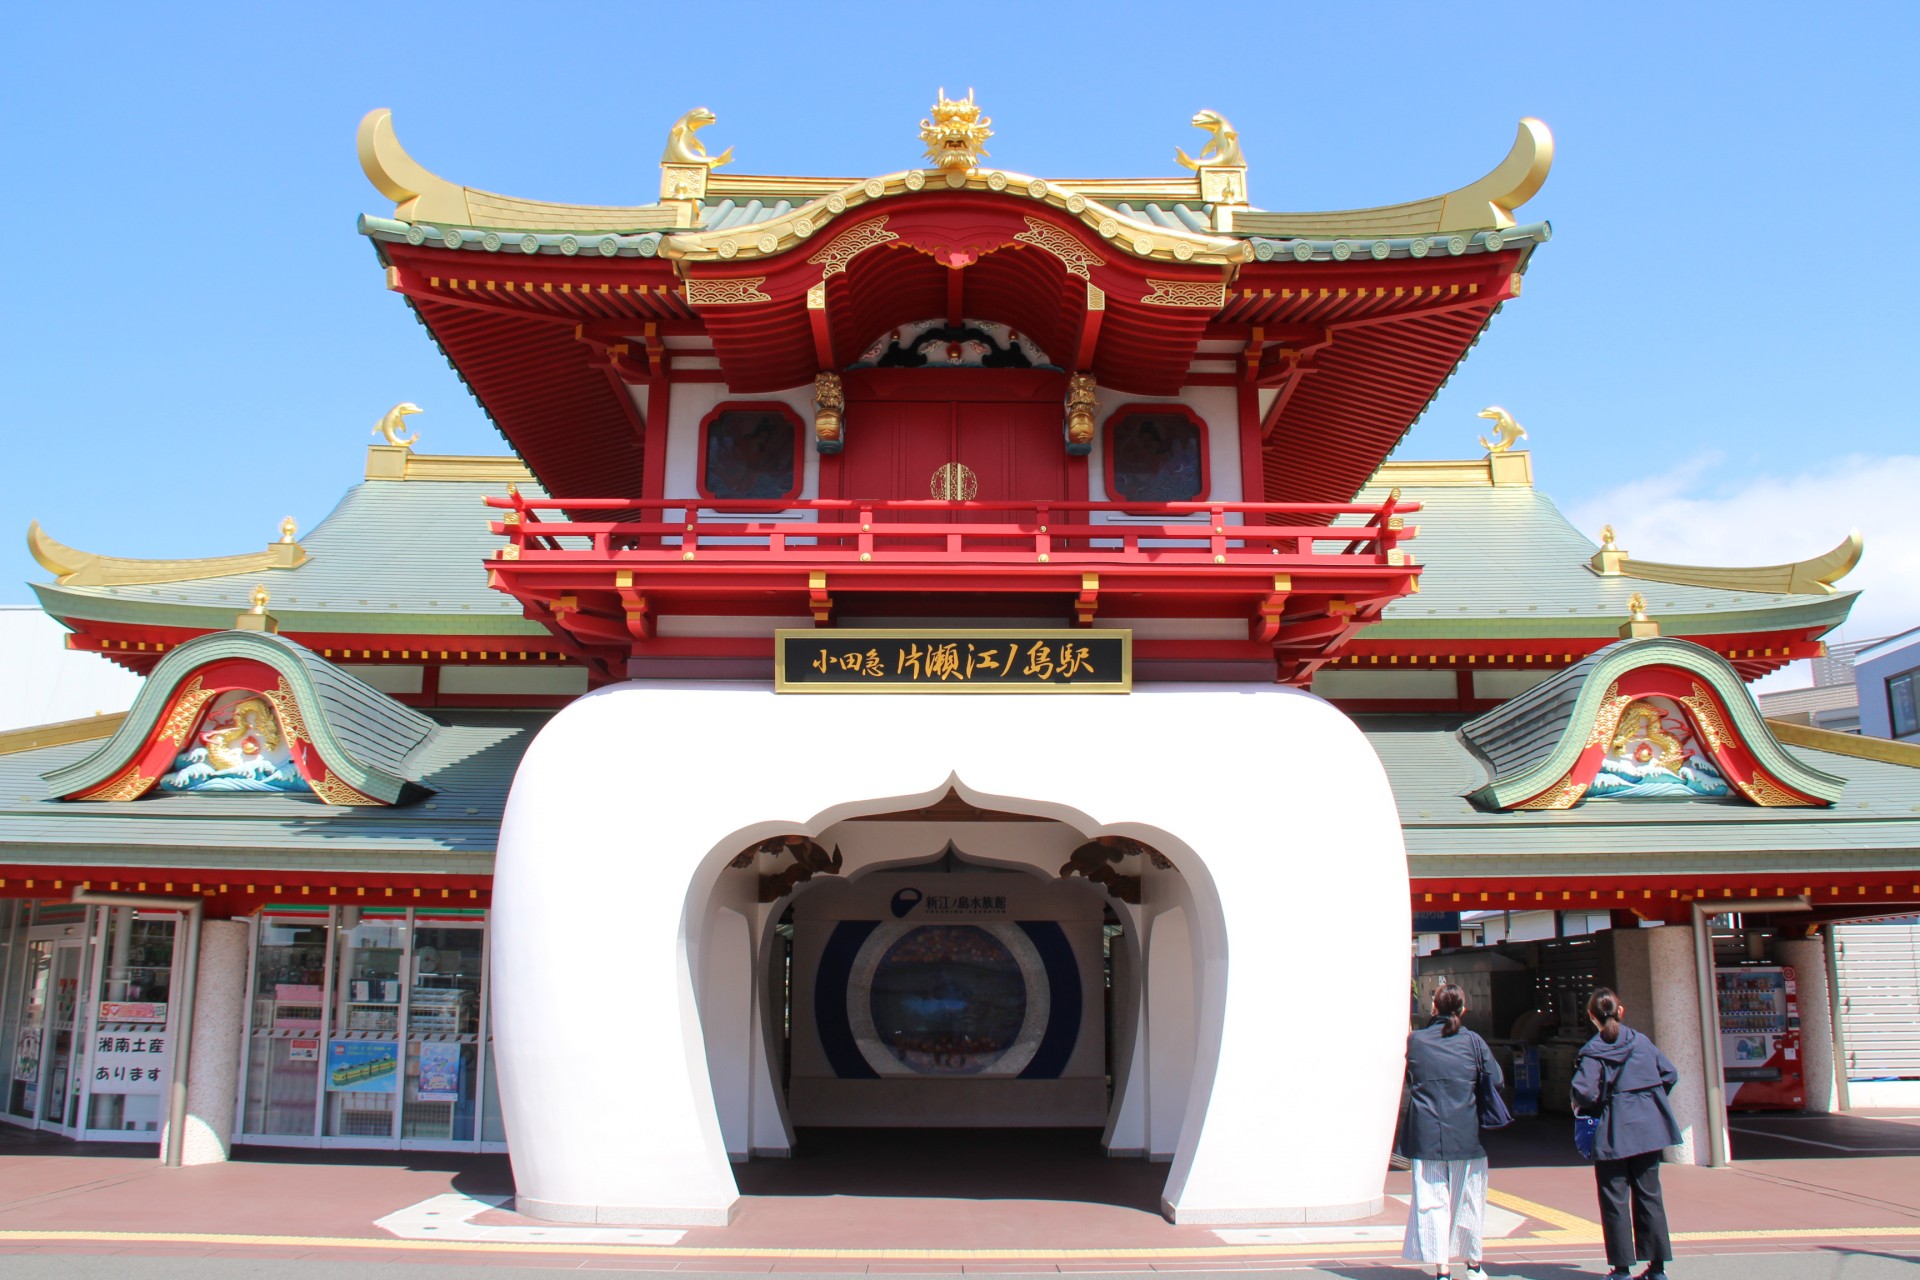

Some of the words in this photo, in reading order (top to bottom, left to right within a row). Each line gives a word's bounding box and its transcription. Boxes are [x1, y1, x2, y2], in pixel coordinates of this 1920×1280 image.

[812, 648, 885, 677] 小田急
[897, 640, 1095, 681] 片瀬江ノ島駅
[927, 896, 1007, 909] 新江ノ島水族館
[98, 1037, 164, 1053] 湘南土産
[96, 1066, 161, 1082] あります
